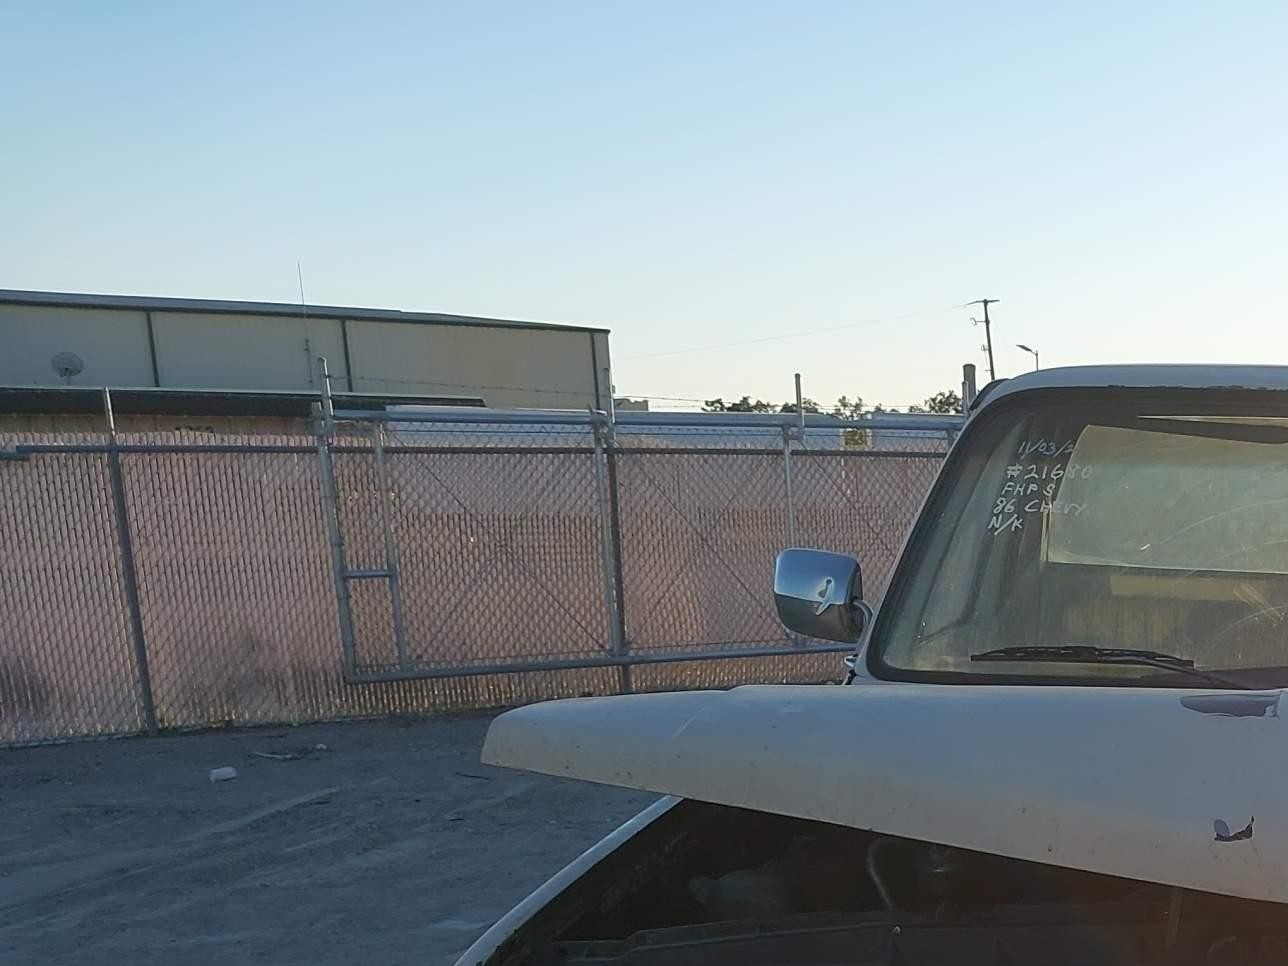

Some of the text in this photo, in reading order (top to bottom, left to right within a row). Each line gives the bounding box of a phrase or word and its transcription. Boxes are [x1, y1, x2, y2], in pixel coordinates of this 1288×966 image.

[993, 498, 1087, 515] 86 CHEVY
[988, 514, 1024, 536] N/K
